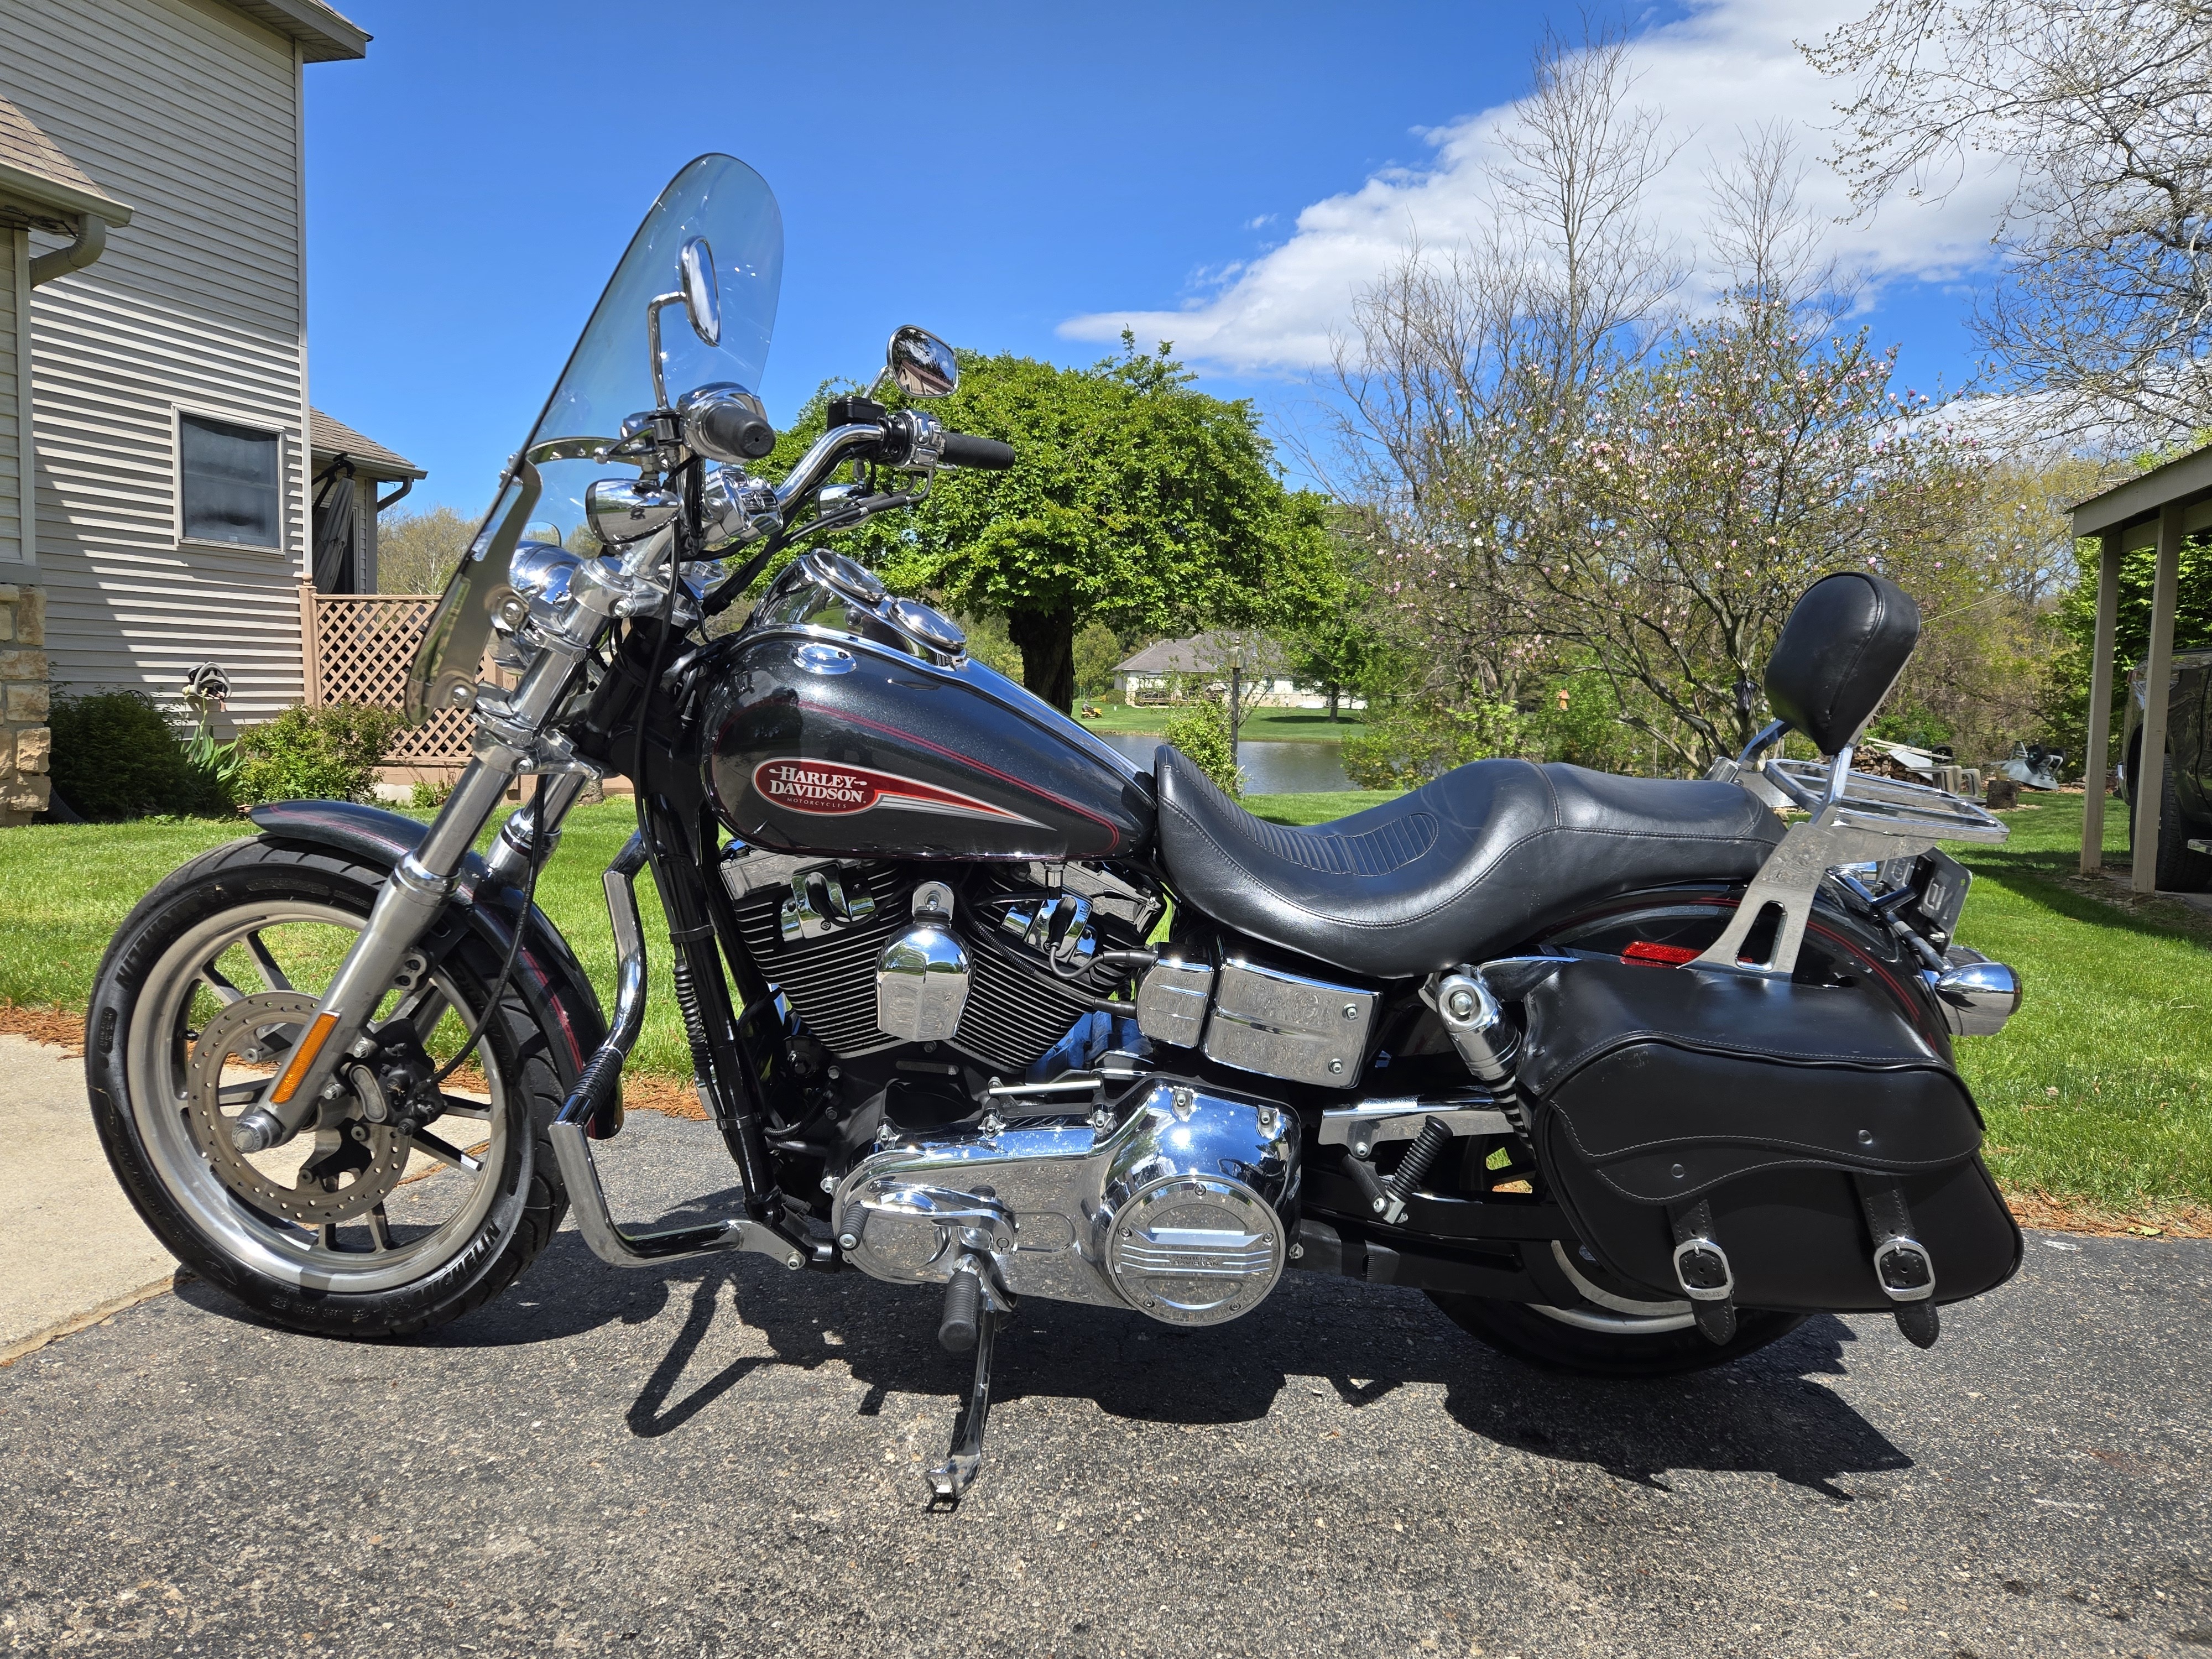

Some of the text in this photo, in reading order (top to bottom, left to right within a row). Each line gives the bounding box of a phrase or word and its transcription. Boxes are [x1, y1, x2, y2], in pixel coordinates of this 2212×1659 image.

[769, 780, 865, 803] DAVIDSON
[787, 797, 847, 808] MOTORCYCLES
[413, 1219, 502, 1301] MICHELIN
